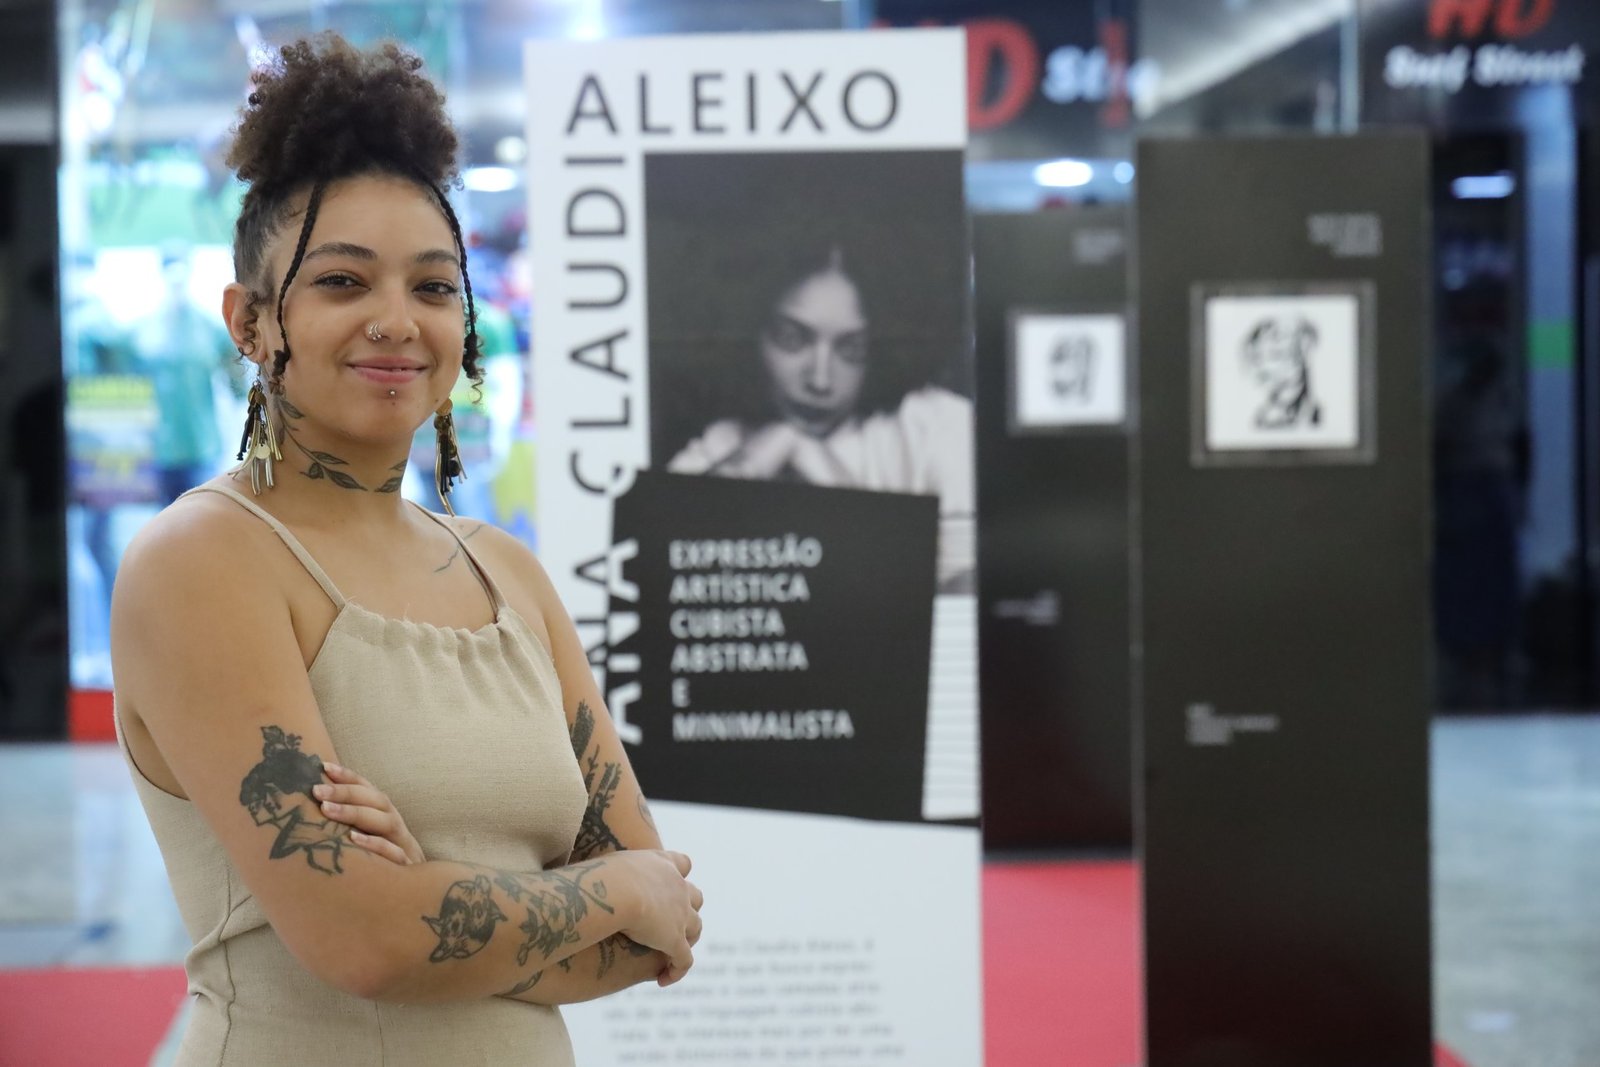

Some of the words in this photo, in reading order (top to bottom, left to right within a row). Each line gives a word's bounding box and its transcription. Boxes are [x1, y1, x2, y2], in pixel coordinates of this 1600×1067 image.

[566, 71, 900, 135] ALEIXO
[669, 533, 823, 569] EXPRESSÃO
[669, 569, 810, 603] ARTÍSTICA
[670, 607, 786, 639] CUBISTA
[670, 642, 809, 673] ABSTRATA
[672, 677, 690, 708] E
[673, 709, 855, 741] MINIMALISTA
